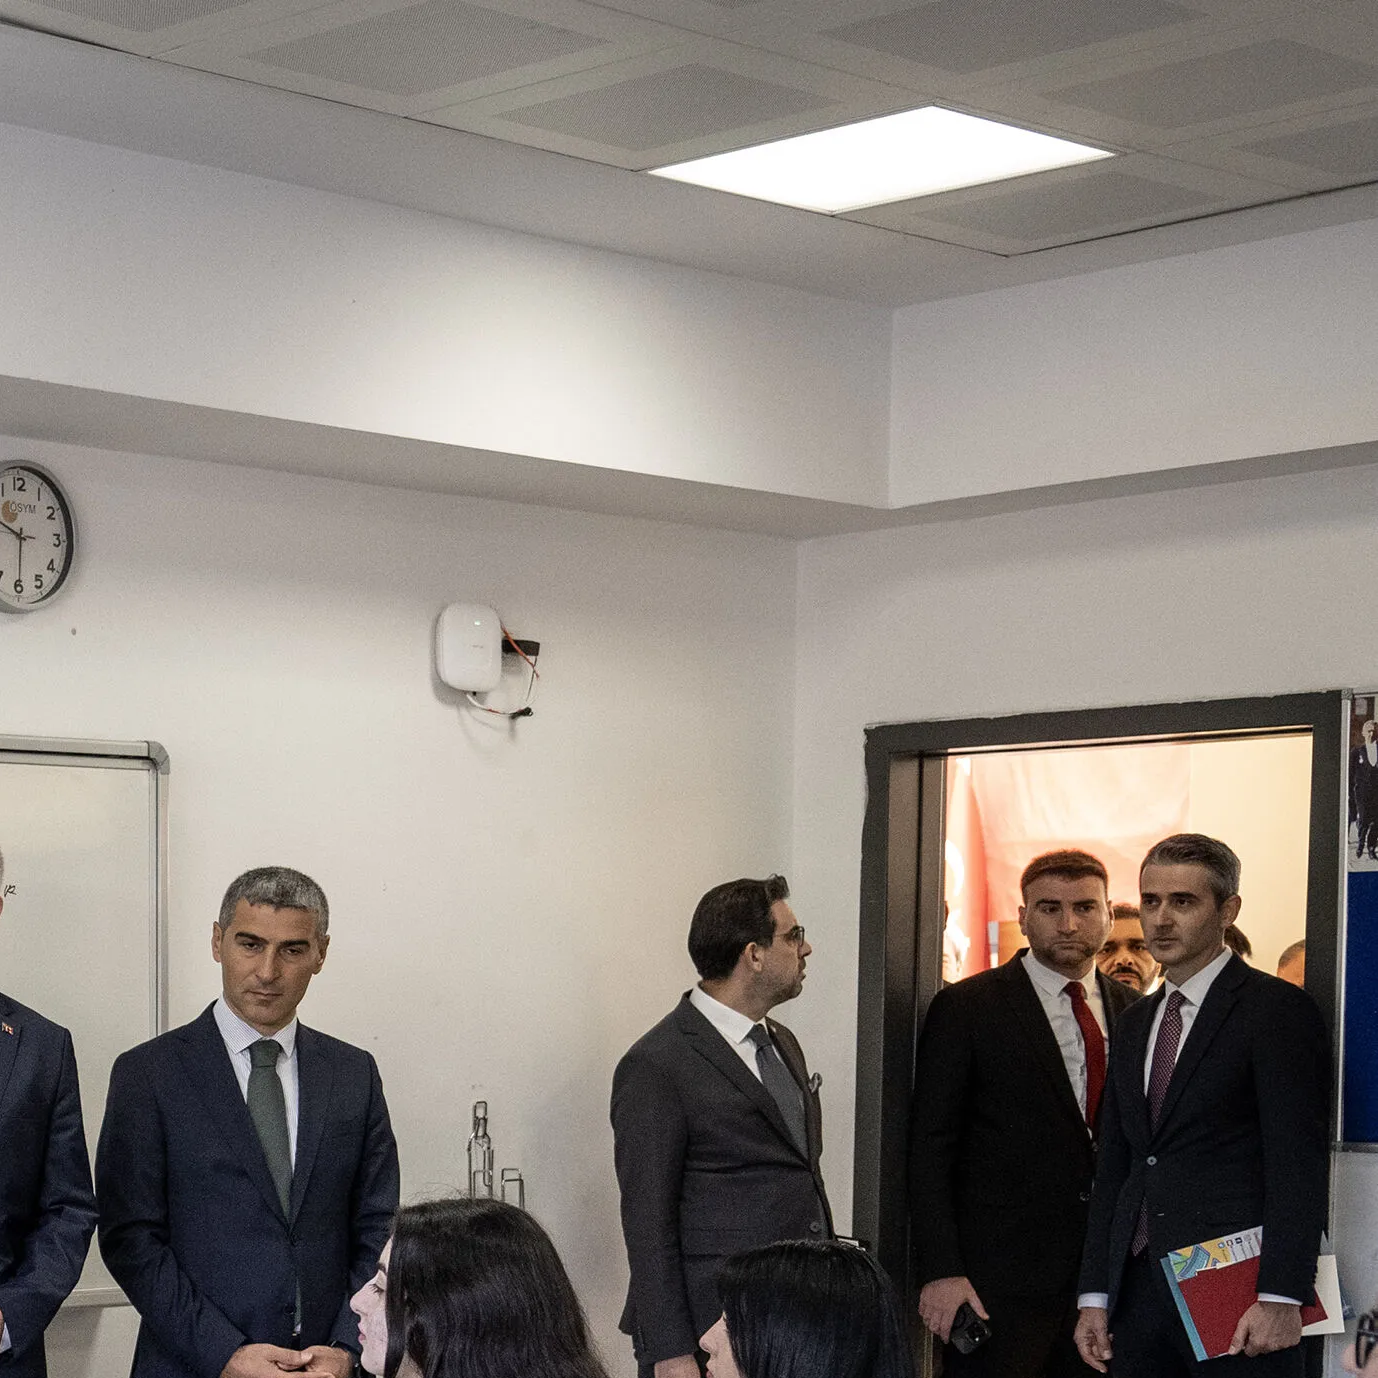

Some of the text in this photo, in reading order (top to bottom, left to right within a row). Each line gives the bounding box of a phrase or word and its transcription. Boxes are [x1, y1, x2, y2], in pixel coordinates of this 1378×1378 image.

[12, 476, 27, 492] 12
[37, 487, 41, 502] 1
[46, 506, 56, 521] 2
[53, 534, 61, 548] 3
[47, 558, 55, 573] 4
[13, 578, 24, 594] 6
[35, 574, 43, 589] 5
